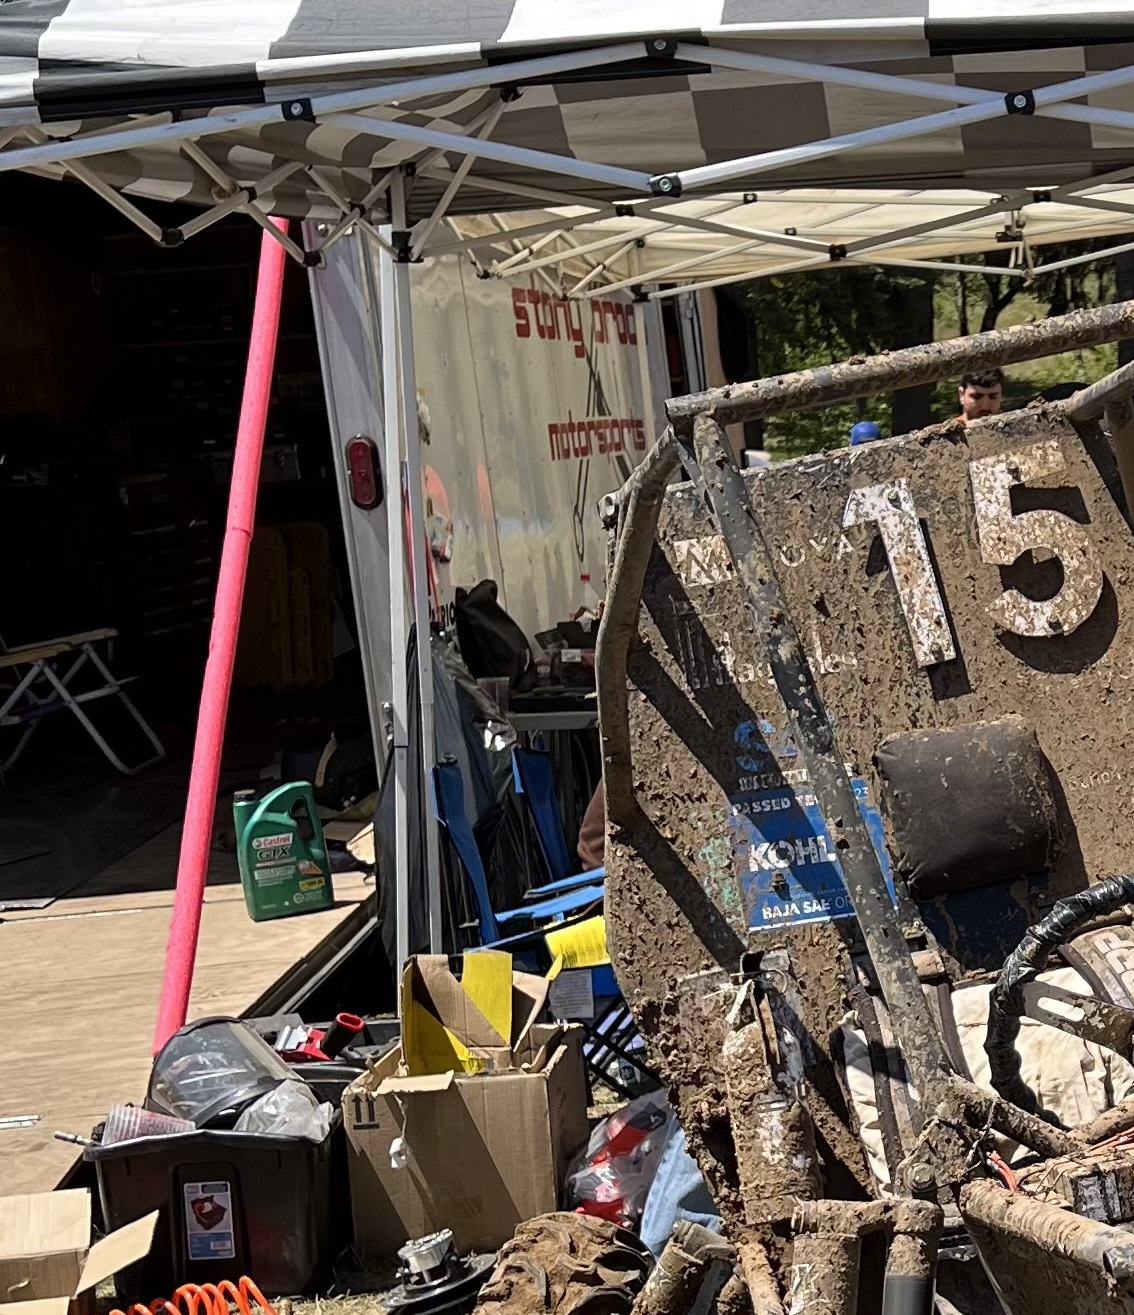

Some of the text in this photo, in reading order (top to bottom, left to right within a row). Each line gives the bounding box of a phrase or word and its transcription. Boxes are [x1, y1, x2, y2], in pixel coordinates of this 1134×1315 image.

[547, 409, 646, 464] motorsports
[842, 438, 1104, 668] 15
[749, 835, 837, 872] KOHL
